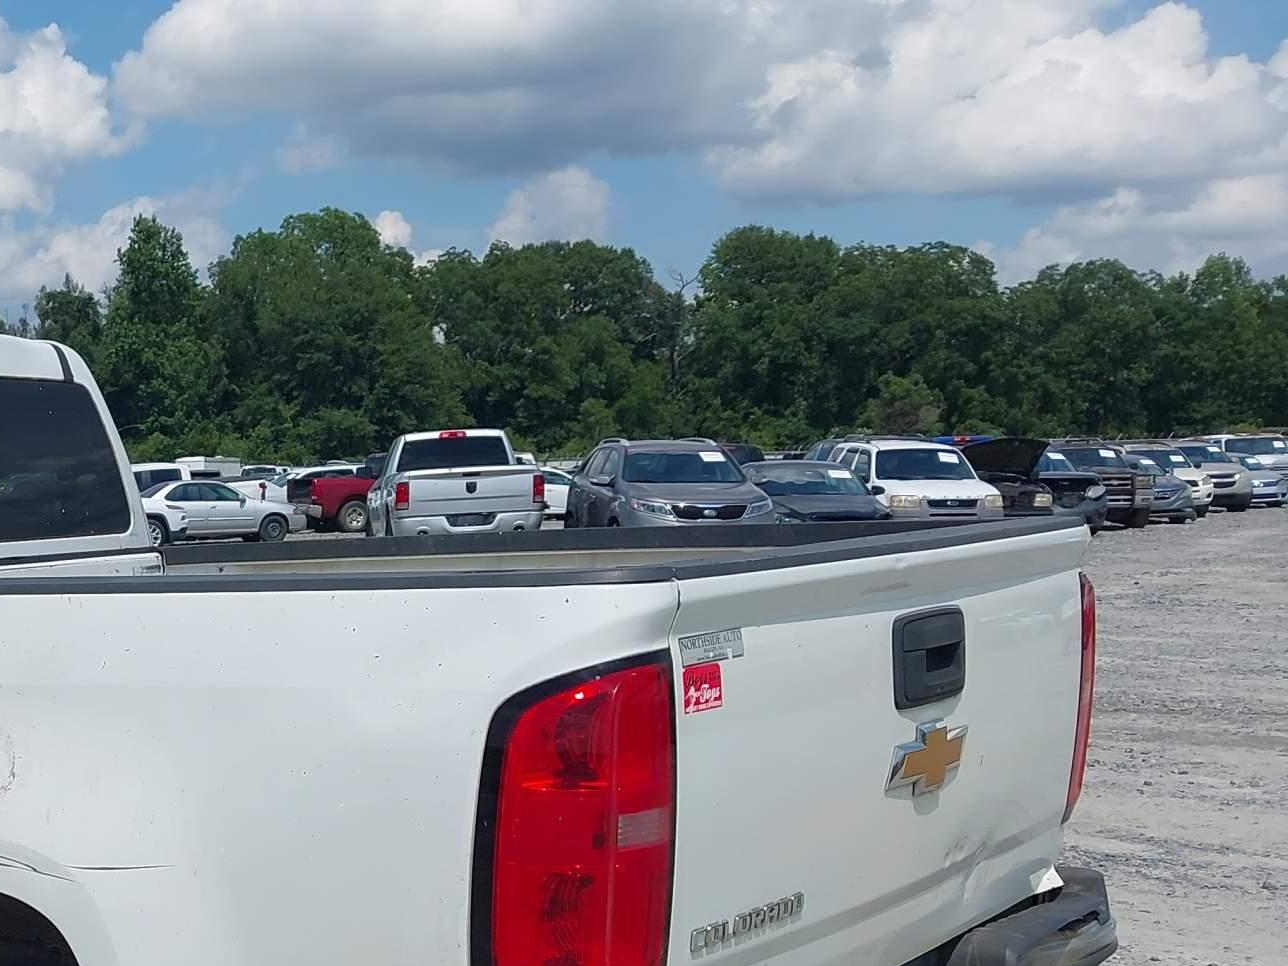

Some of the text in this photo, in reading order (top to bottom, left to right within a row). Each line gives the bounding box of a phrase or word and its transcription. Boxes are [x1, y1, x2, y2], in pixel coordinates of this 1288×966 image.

[680, 633, 722, 652] NORTHSIDE
[722, 630, 742, 643] AUTO
[690, 891, 805, 953] COLORADO
